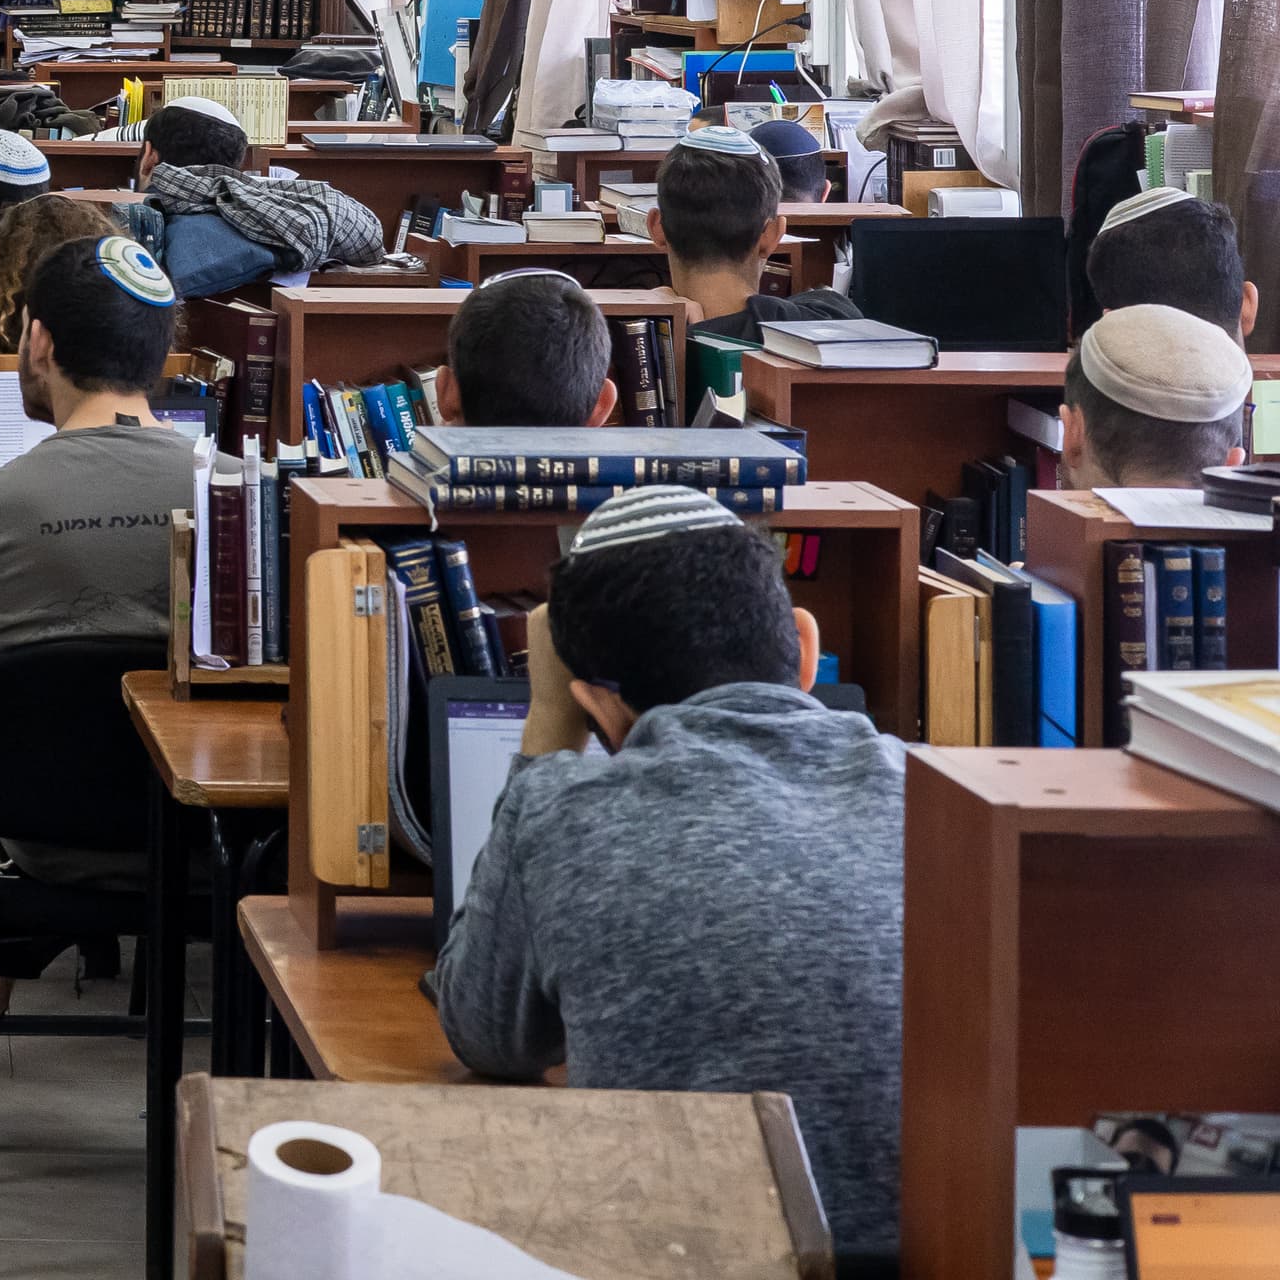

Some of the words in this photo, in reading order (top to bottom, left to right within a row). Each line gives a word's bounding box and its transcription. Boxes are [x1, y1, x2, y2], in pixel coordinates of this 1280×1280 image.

[635, 336, 647, 366] תלמוד
[640, 367, 650, 388] בבלי
[40, 517, 102, 535] אמונה
[108, 513, 169, 528] נוגעת
